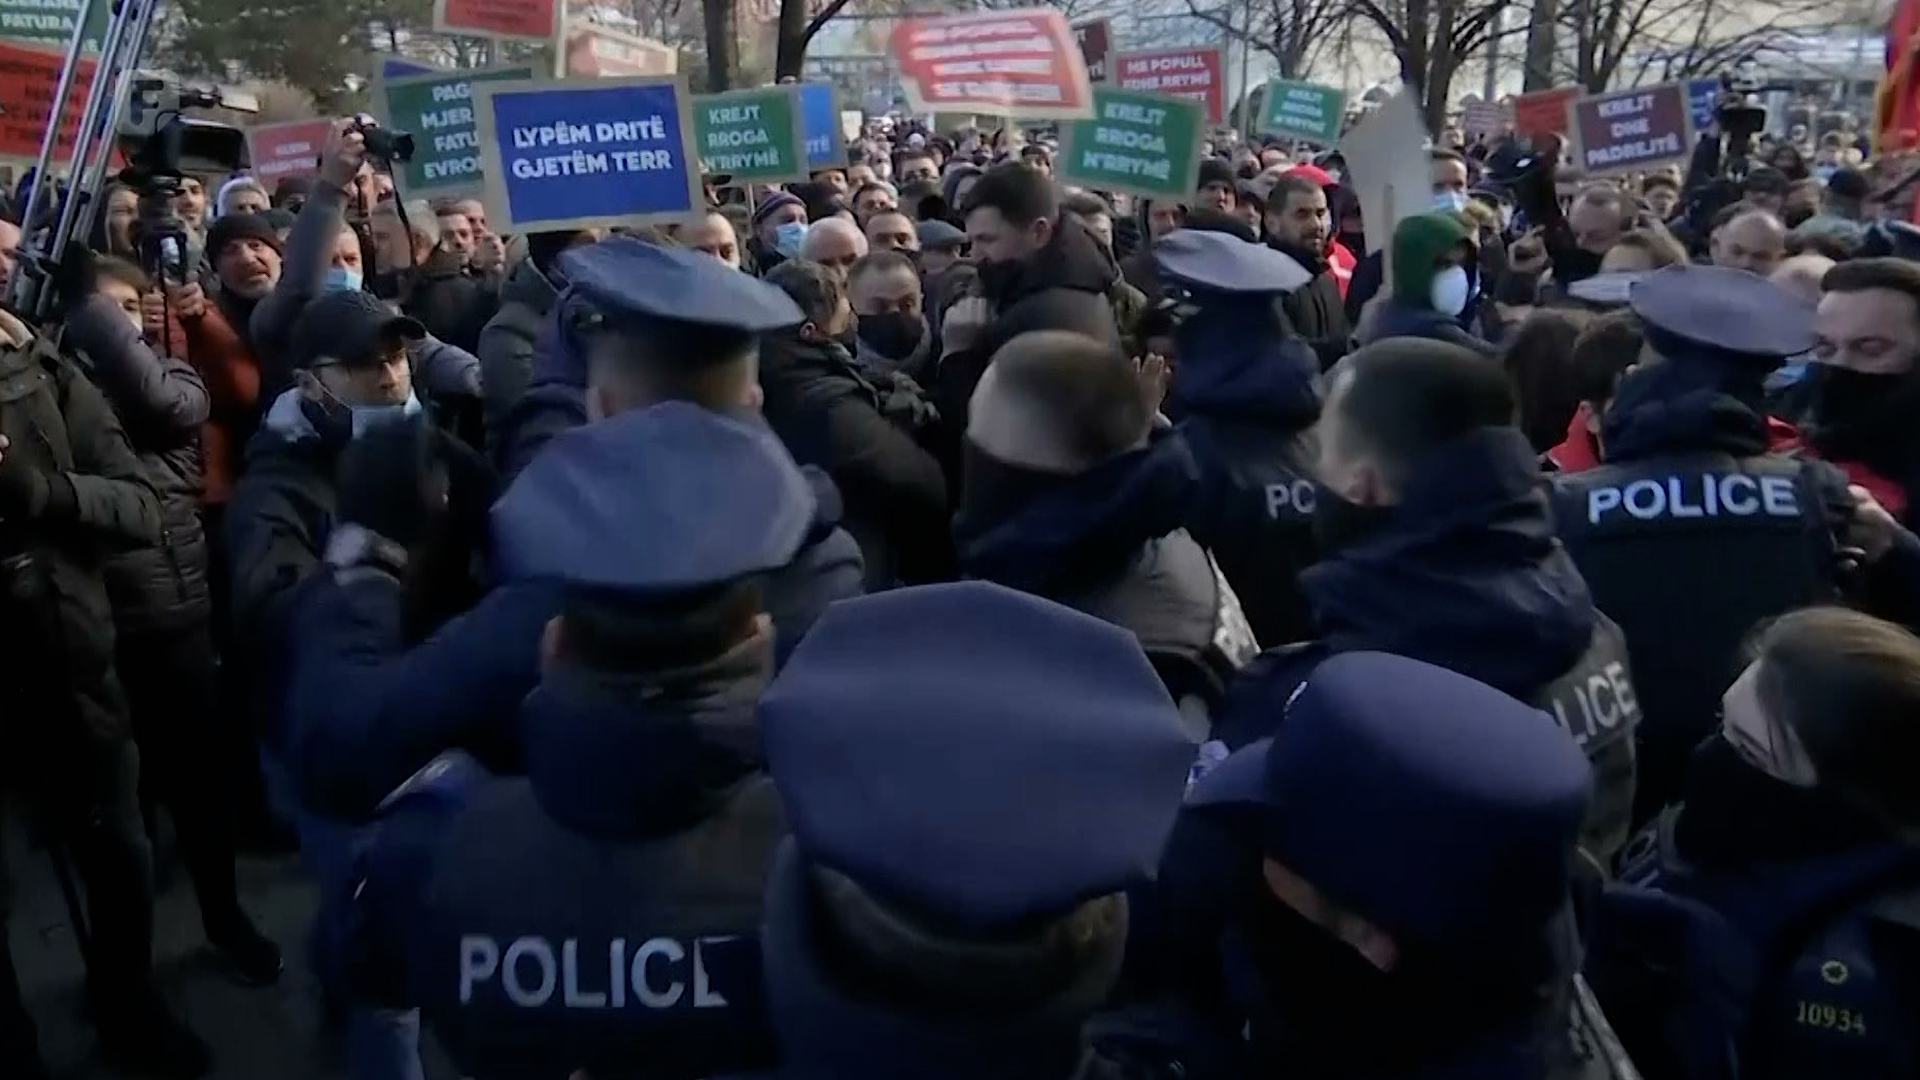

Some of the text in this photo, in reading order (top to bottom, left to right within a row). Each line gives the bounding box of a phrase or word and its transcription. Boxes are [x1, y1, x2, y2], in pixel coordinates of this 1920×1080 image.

[1151, 54, 1206, 71] POPULL
[709, 105, 760, 125] KREJT
[1104, 101, 1167, 126] KREJT
[513, 114, 666, 149] LYPËM DRITË
[707, 128, 768, 148] RROGA
[1095, 126, 1167, 153] RROGA
[512, 149, 673, 179] GJETËM TERR
[1588, 473, 1801, 525] POLICE
[1797, 1000, 1866, 1036] 10934
